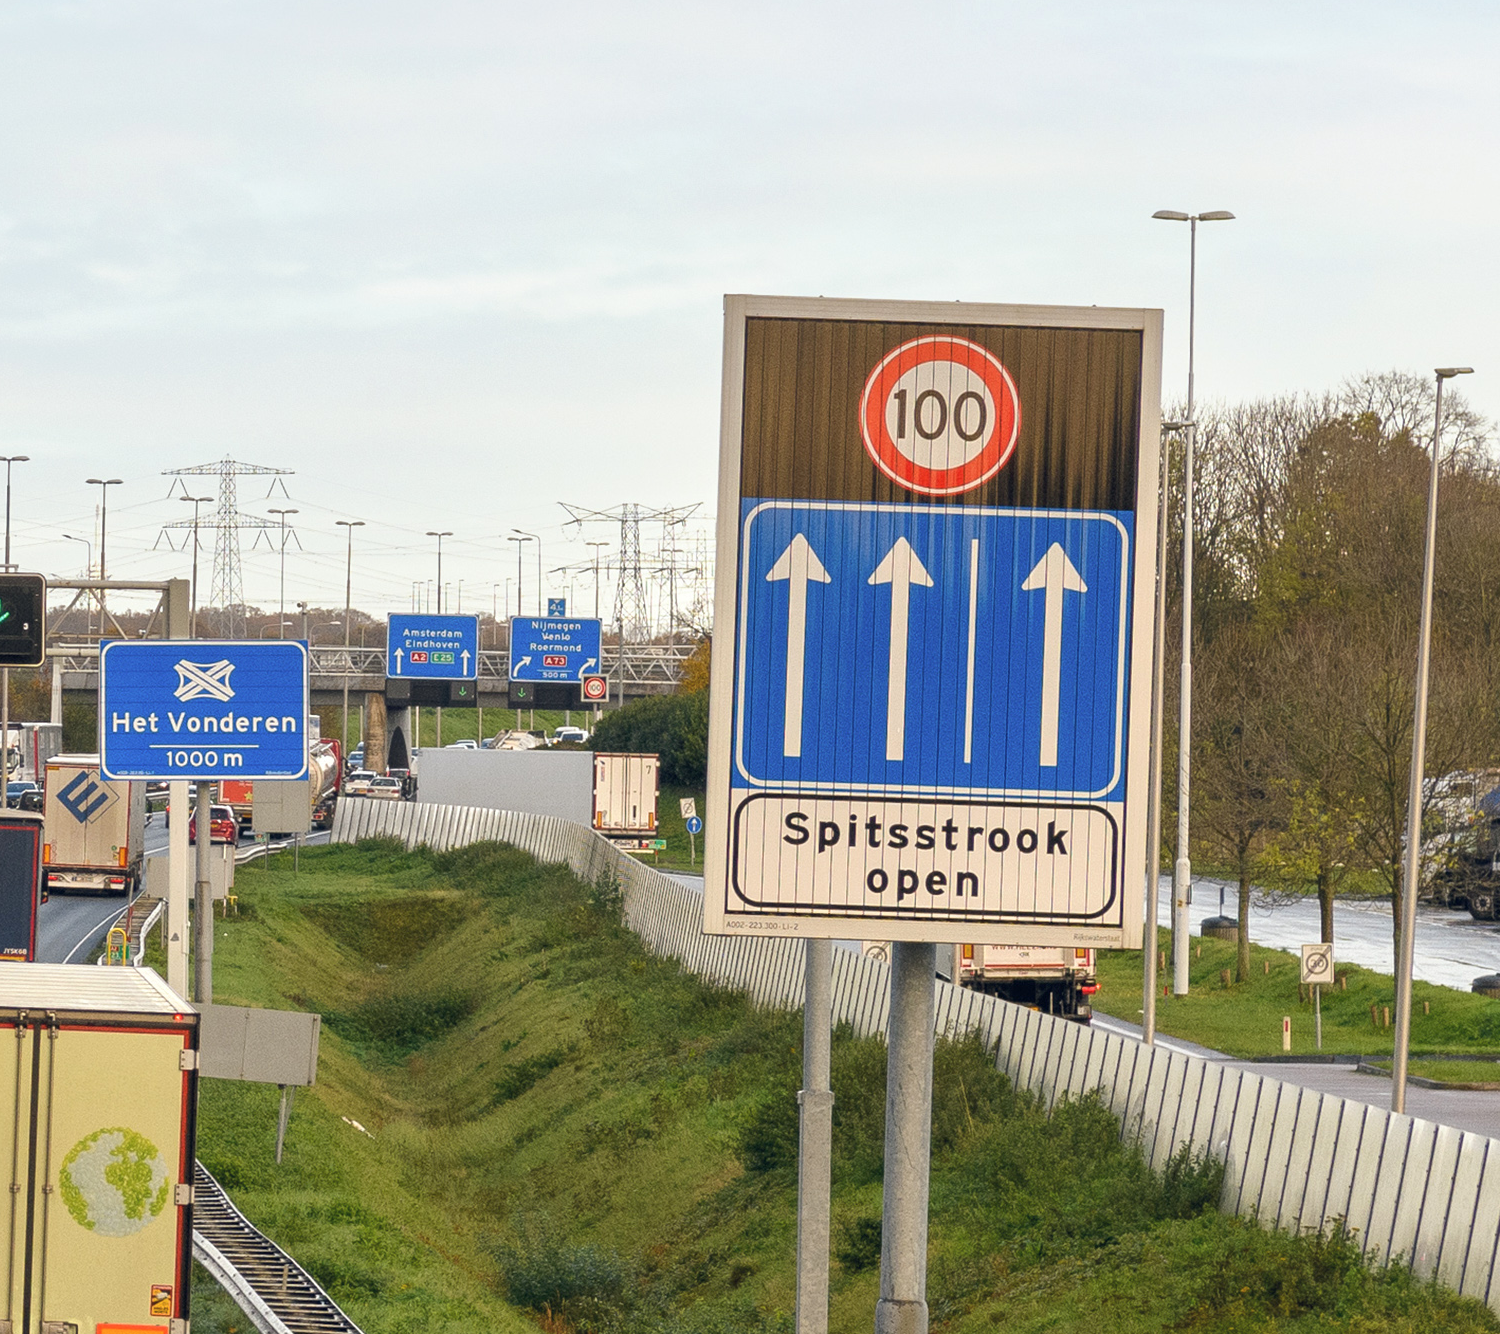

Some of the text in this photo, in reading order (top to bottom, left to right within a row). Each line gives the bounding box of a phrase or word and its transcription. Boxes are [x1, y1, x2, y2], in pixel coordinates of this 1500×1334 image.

[894, 389, 987, 442] 100
[531, 621, 581, 632] Nijmegen
[403, 628, 463, 638] Amsterdam
[541, 632, 571, 641] Venlo
[405, 639, 460, 649] Eindhoven
[530, 642, 582, 652] Roermond
[545, 657, 565, 665] A73
[112, 712, 297, 733] Het Vonderen
[166, 751, 243, 767] 1000 m
[782, 811, 1069, 856] Spitsstrook
[866, 868, 979, 903] open
